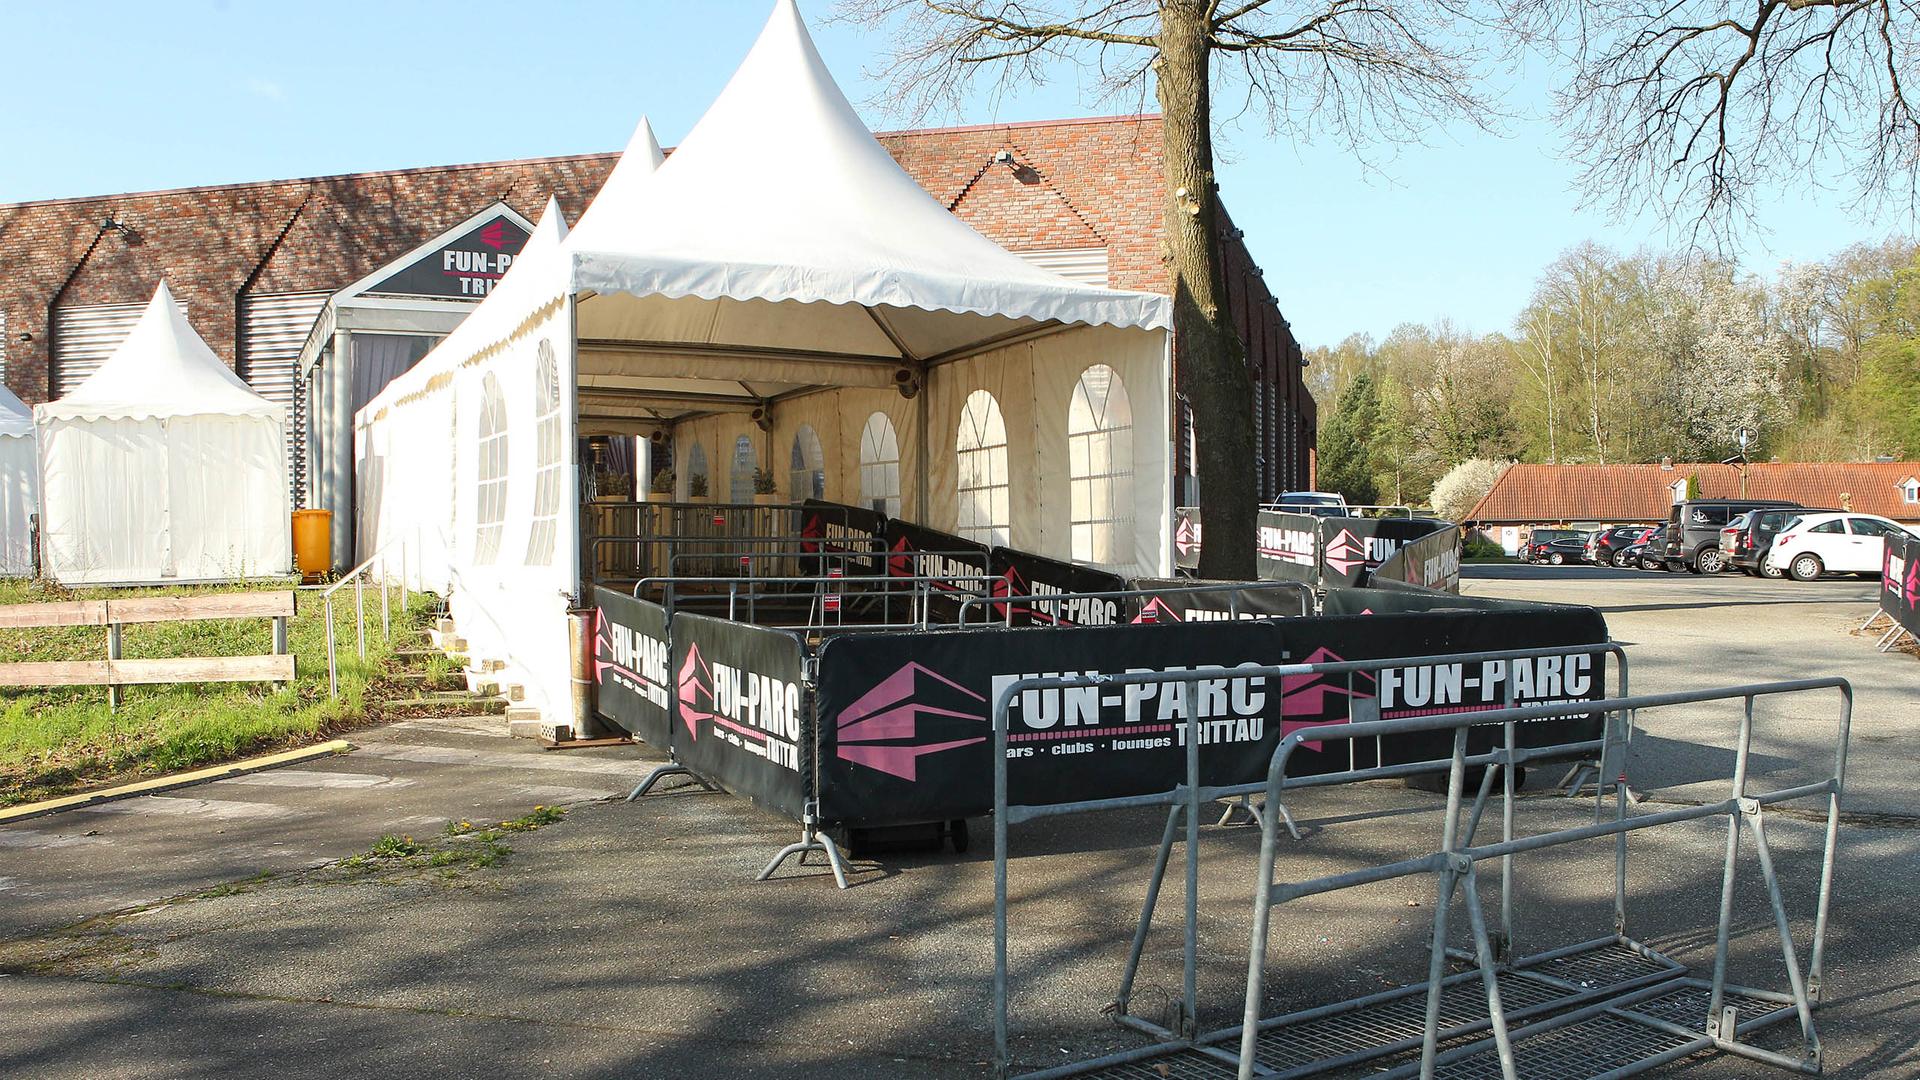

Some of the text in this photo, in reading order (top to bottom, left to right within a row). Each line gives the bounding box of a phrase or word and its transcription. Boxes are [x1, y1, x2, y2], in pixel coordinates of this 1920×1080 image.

[443, 250, 519, 273] FUN-P
[459, 277, 499, 294] TRI
[612, 622, 668, 687] FUN-PARC
[1380, 653, 1591, 709] FUN-PARC
[712, 662, 800, 742] FUN-PARC
[992, 661, 1266, 731] FUN-PARC
[1006, 737, 1171, 758] ars clubs lounges
